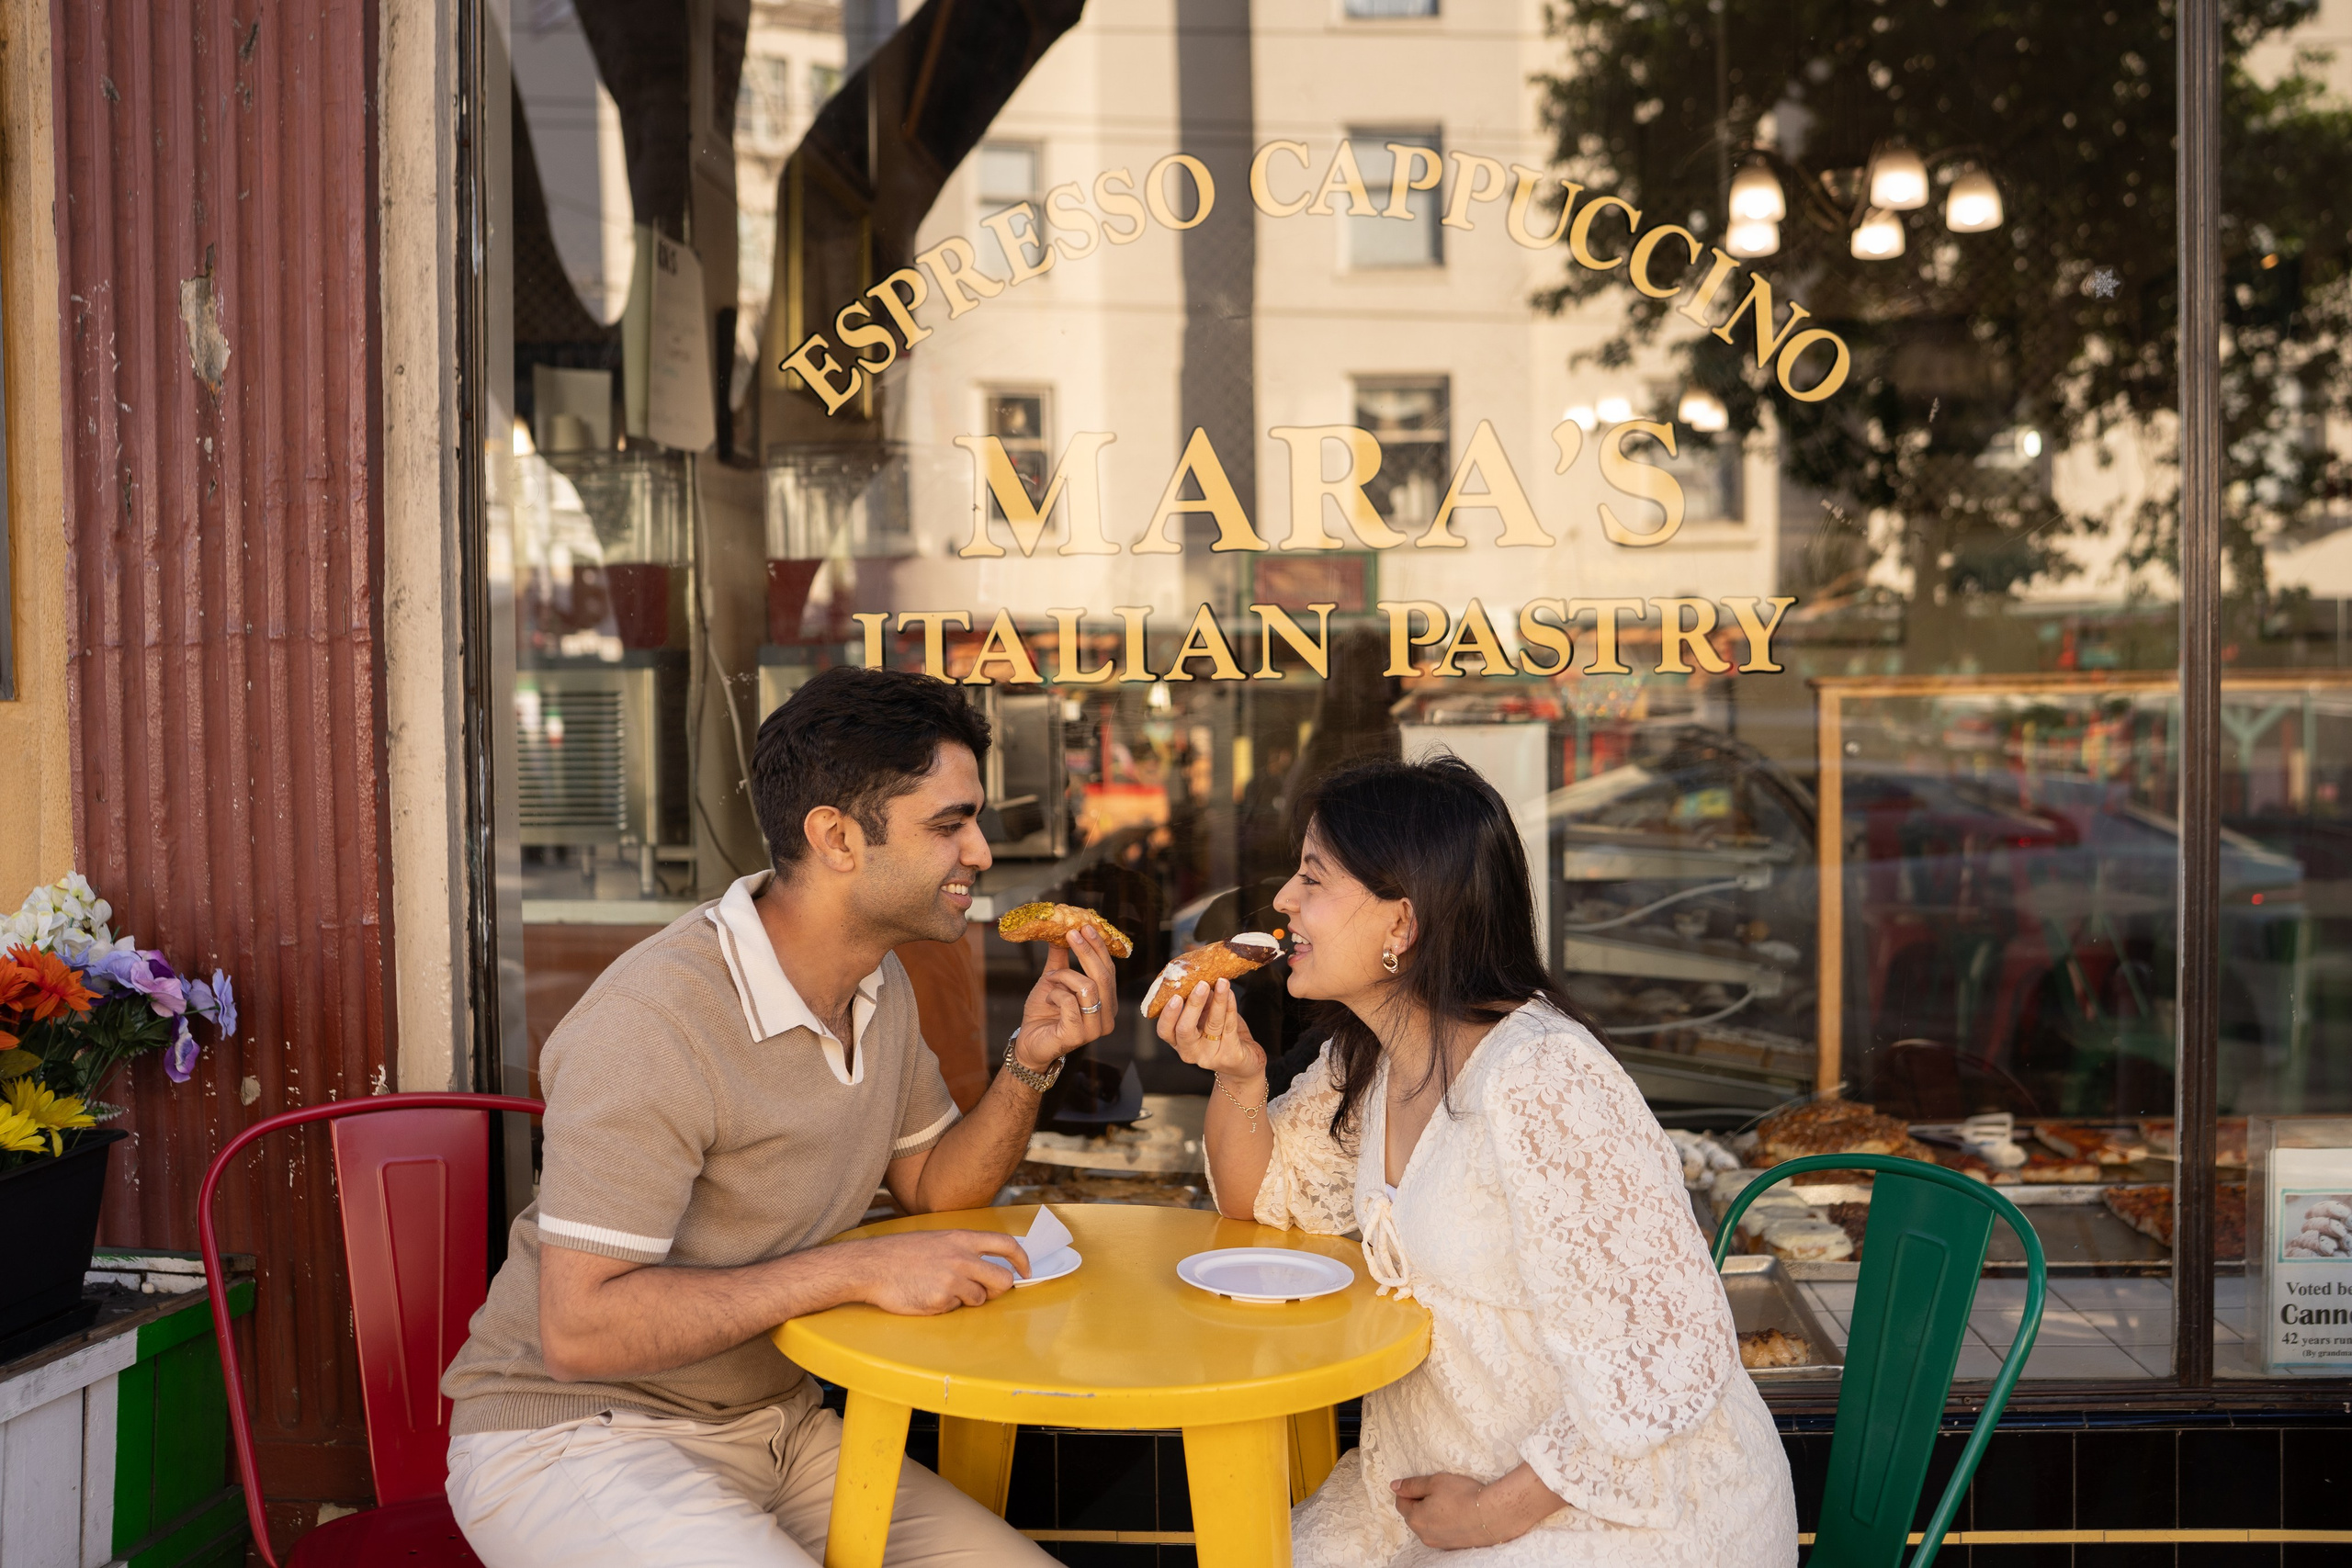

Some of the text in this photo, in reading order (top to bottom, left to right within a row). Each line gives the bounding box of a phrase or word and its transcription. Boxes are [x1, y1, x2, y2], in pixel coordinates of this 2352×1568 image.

[779, 152, 1216, 417] ESPRESSO
[1250, 139, 1850, 402] CAPPUCCINO
[953, 419, 1686, 558] MARA'S
[852, 595, 1799, 685] ITALIAN PASTRY
[2286, 1281, 2332, 1296] Voted
[2280, 1303, 2352, 1325] Cann
[2281, 1332, 2298, 1345] 42
[2301, 1337, 2331, 1347] years
[2301, 1349, 2315, 1358] (By
